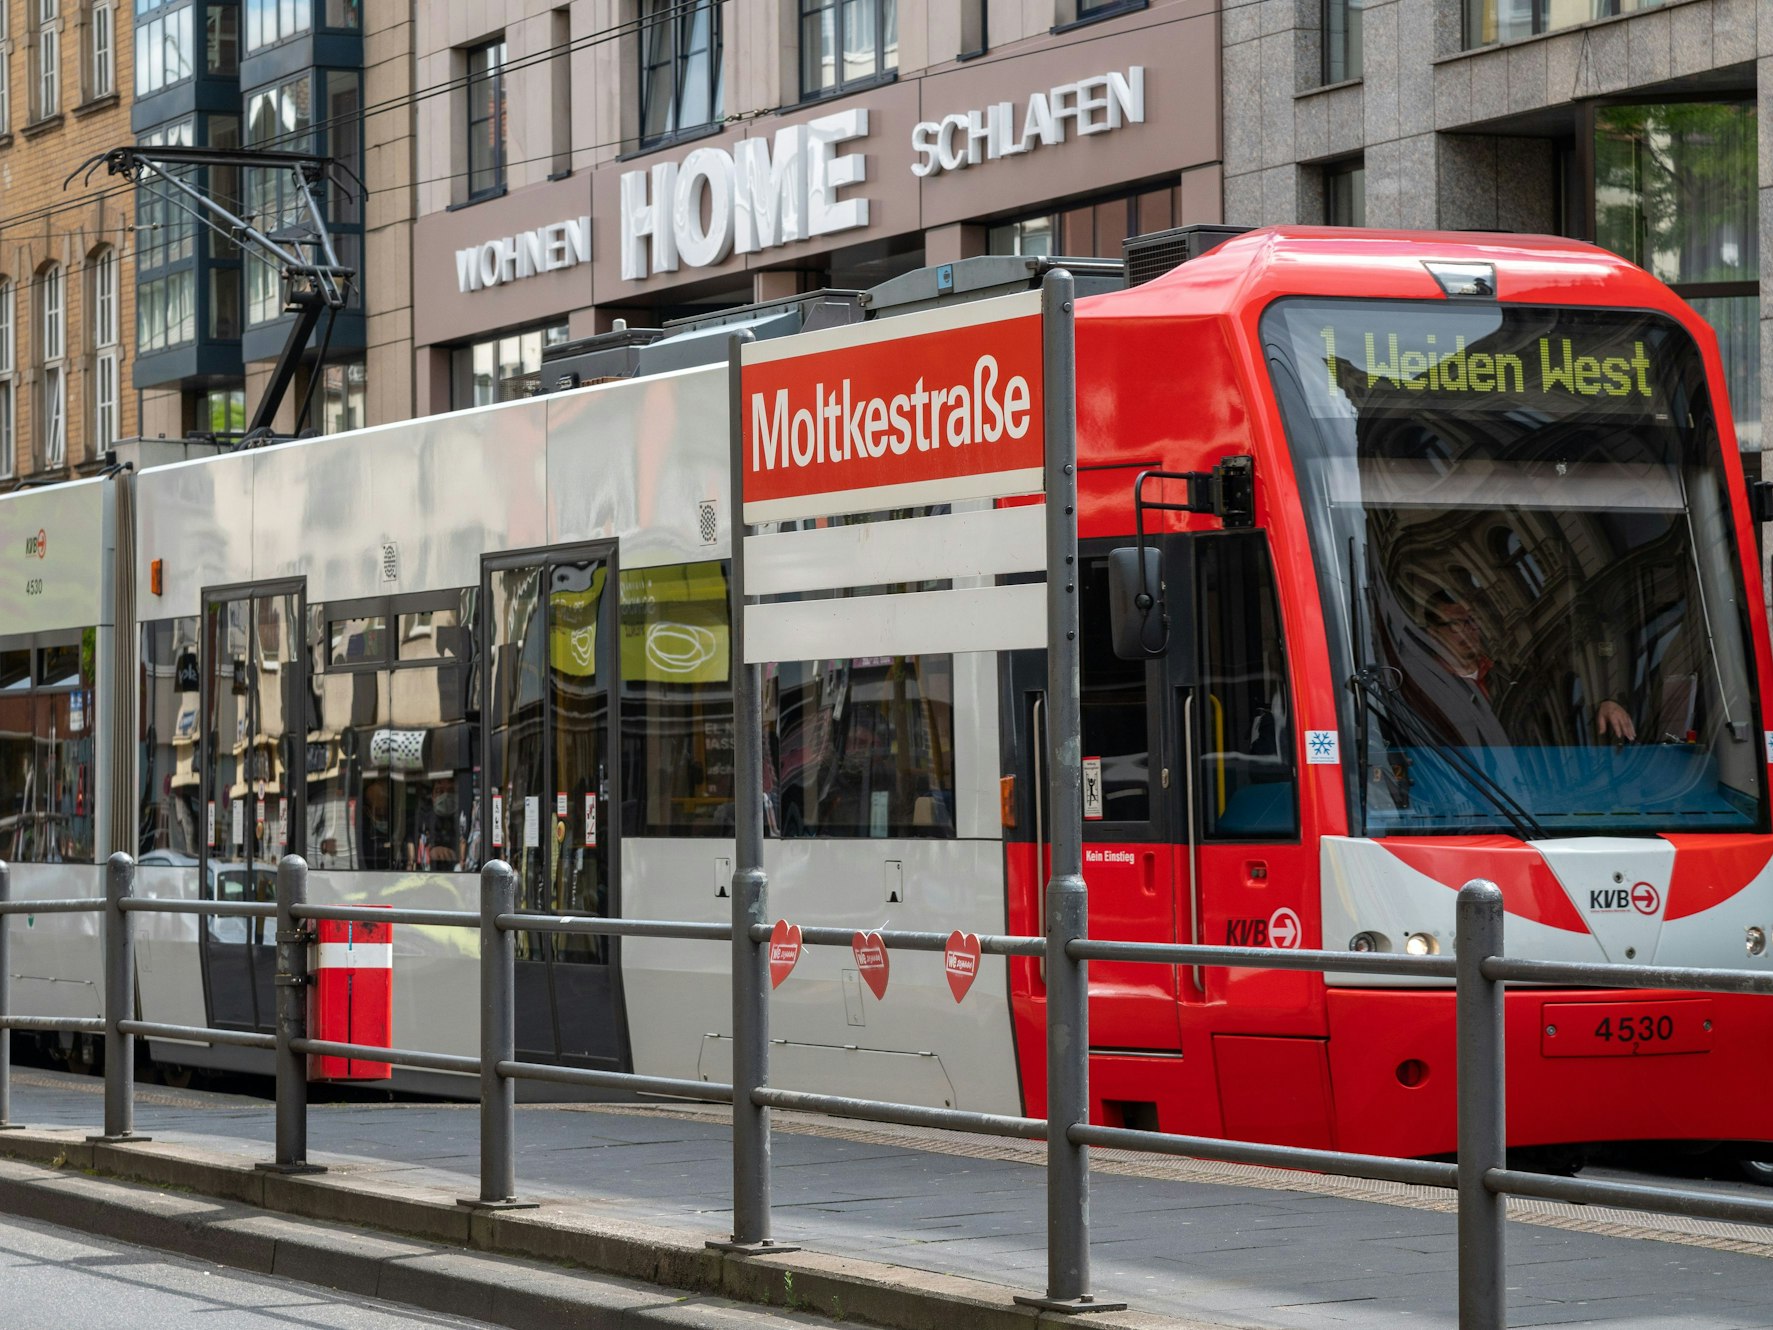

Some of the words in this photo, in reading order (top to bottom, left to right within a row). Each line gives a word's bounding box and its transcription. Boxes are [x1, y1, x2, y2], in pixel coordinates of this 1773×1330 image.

[911, 65, 1144, 176] SCHLAFEN
[621, 108, 869, 281] HOME
[455, 216, 591, 292] WOHNEN
[1320, 325, 1338, 397] 1
[1364, 332, 1525, 393] Weiden
[1539, 338, 1652, 397] West
[752, 354, 1030, 471] Moltkestraße
[26, 579, 43, 596] 4530
[1086, 850, 1103, 862] Kein
[1104, 850, 1135, 865] Einstieg
[1590, 889, 1630, 909] KVB
[1226, 919, 1267, 946] KVB
[1595, 1015, 1673, 1042] 4530
